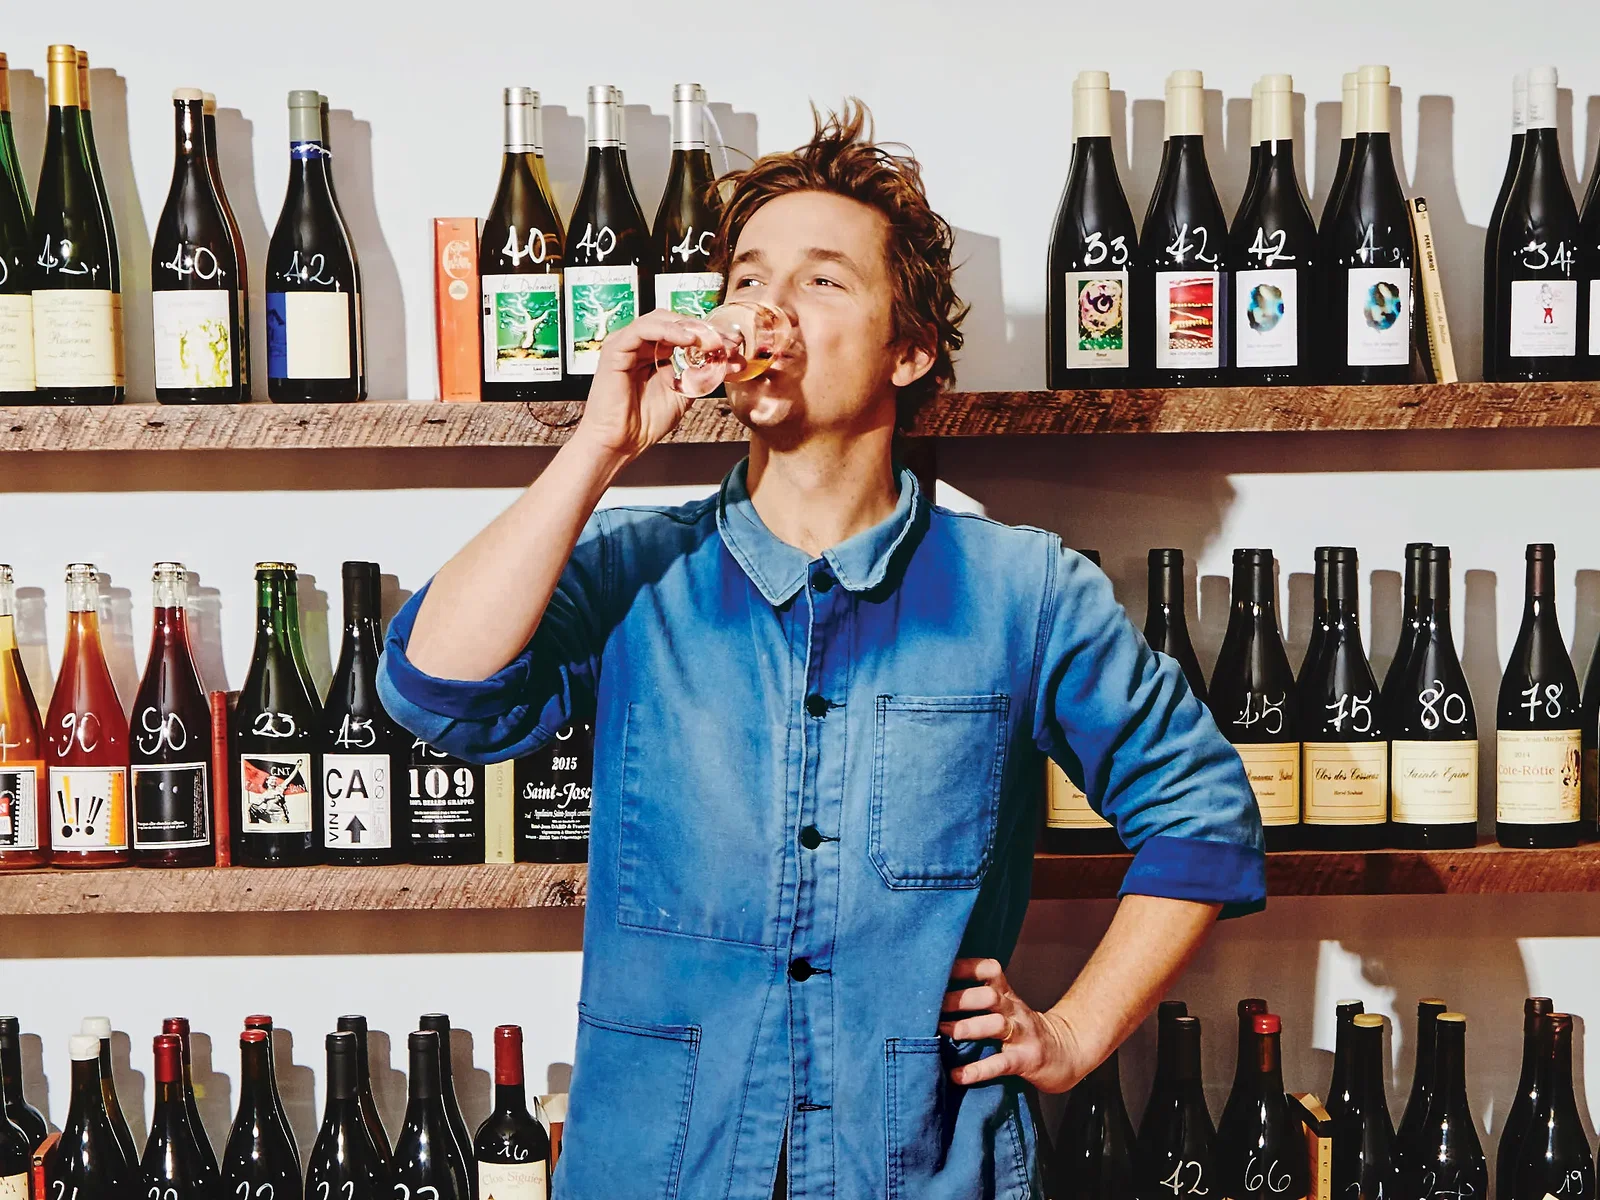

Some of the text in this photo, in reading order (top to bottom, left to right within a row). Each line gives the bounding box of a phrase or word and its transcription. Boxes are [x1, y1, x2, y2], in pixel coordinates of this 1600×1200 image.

[502, 225, 547, 266] 40
[576, 222, 616, 259] 40
[1084, 232, 1128, 265] 33
[1166, 223, 1218, 263] 42
[1248, 227, 1296, 263] 42
[1325, 689, 1372, 733] 75
[1418, 679, 1467, 730] 80
[1520, 681, 1564, 722] 78
[252, 712, 296, 738] 23
[551, 756, 578, 771] 2015
[408, 767, 475, 799] 109
[522, 782, 592, 809] Saint-Jose
[328, 813, 339, 842] VIN
[1159, 1160, 1209, 1196] 42
[1244, 1156, 1292, 1193] 66
